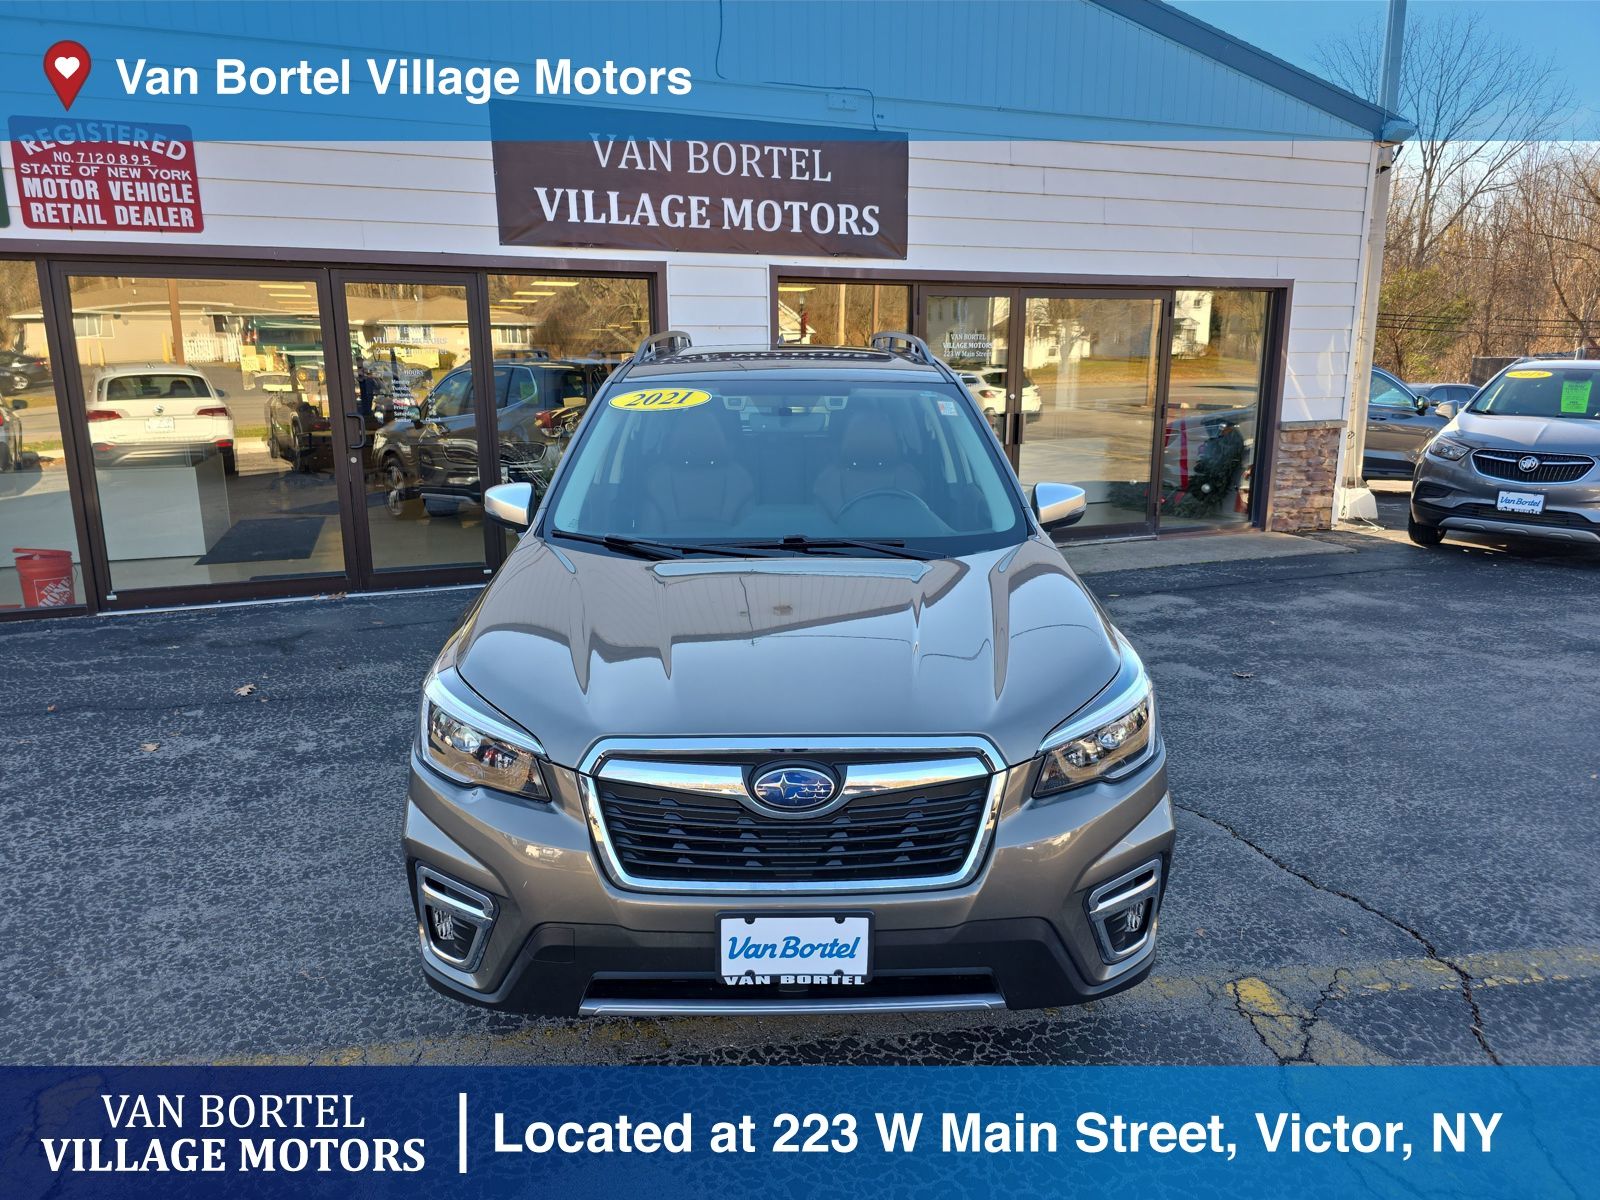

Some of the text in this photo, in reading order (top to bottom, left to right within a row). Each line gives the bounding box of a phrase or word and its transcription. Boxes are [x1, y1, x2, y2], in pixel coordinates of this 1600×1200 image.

[18, 122, 187, 161] REGISTERED
[53, 151, 151, 165] NO. 7120895
[589, 133, 832, 182] VAN BORTEL
[20, 163, 192, 181] STATE OF NEW YORK
[22, 177, 195, 204] MOTOR VEHICLE
[30, 202, 195, 228] RETAIL DEALER
[534, 187, 880, 236] VILLAGE MOTORS
[624, 391, 694, 407] 2021
[723, 975, 865, 986] VAN BORTEL
